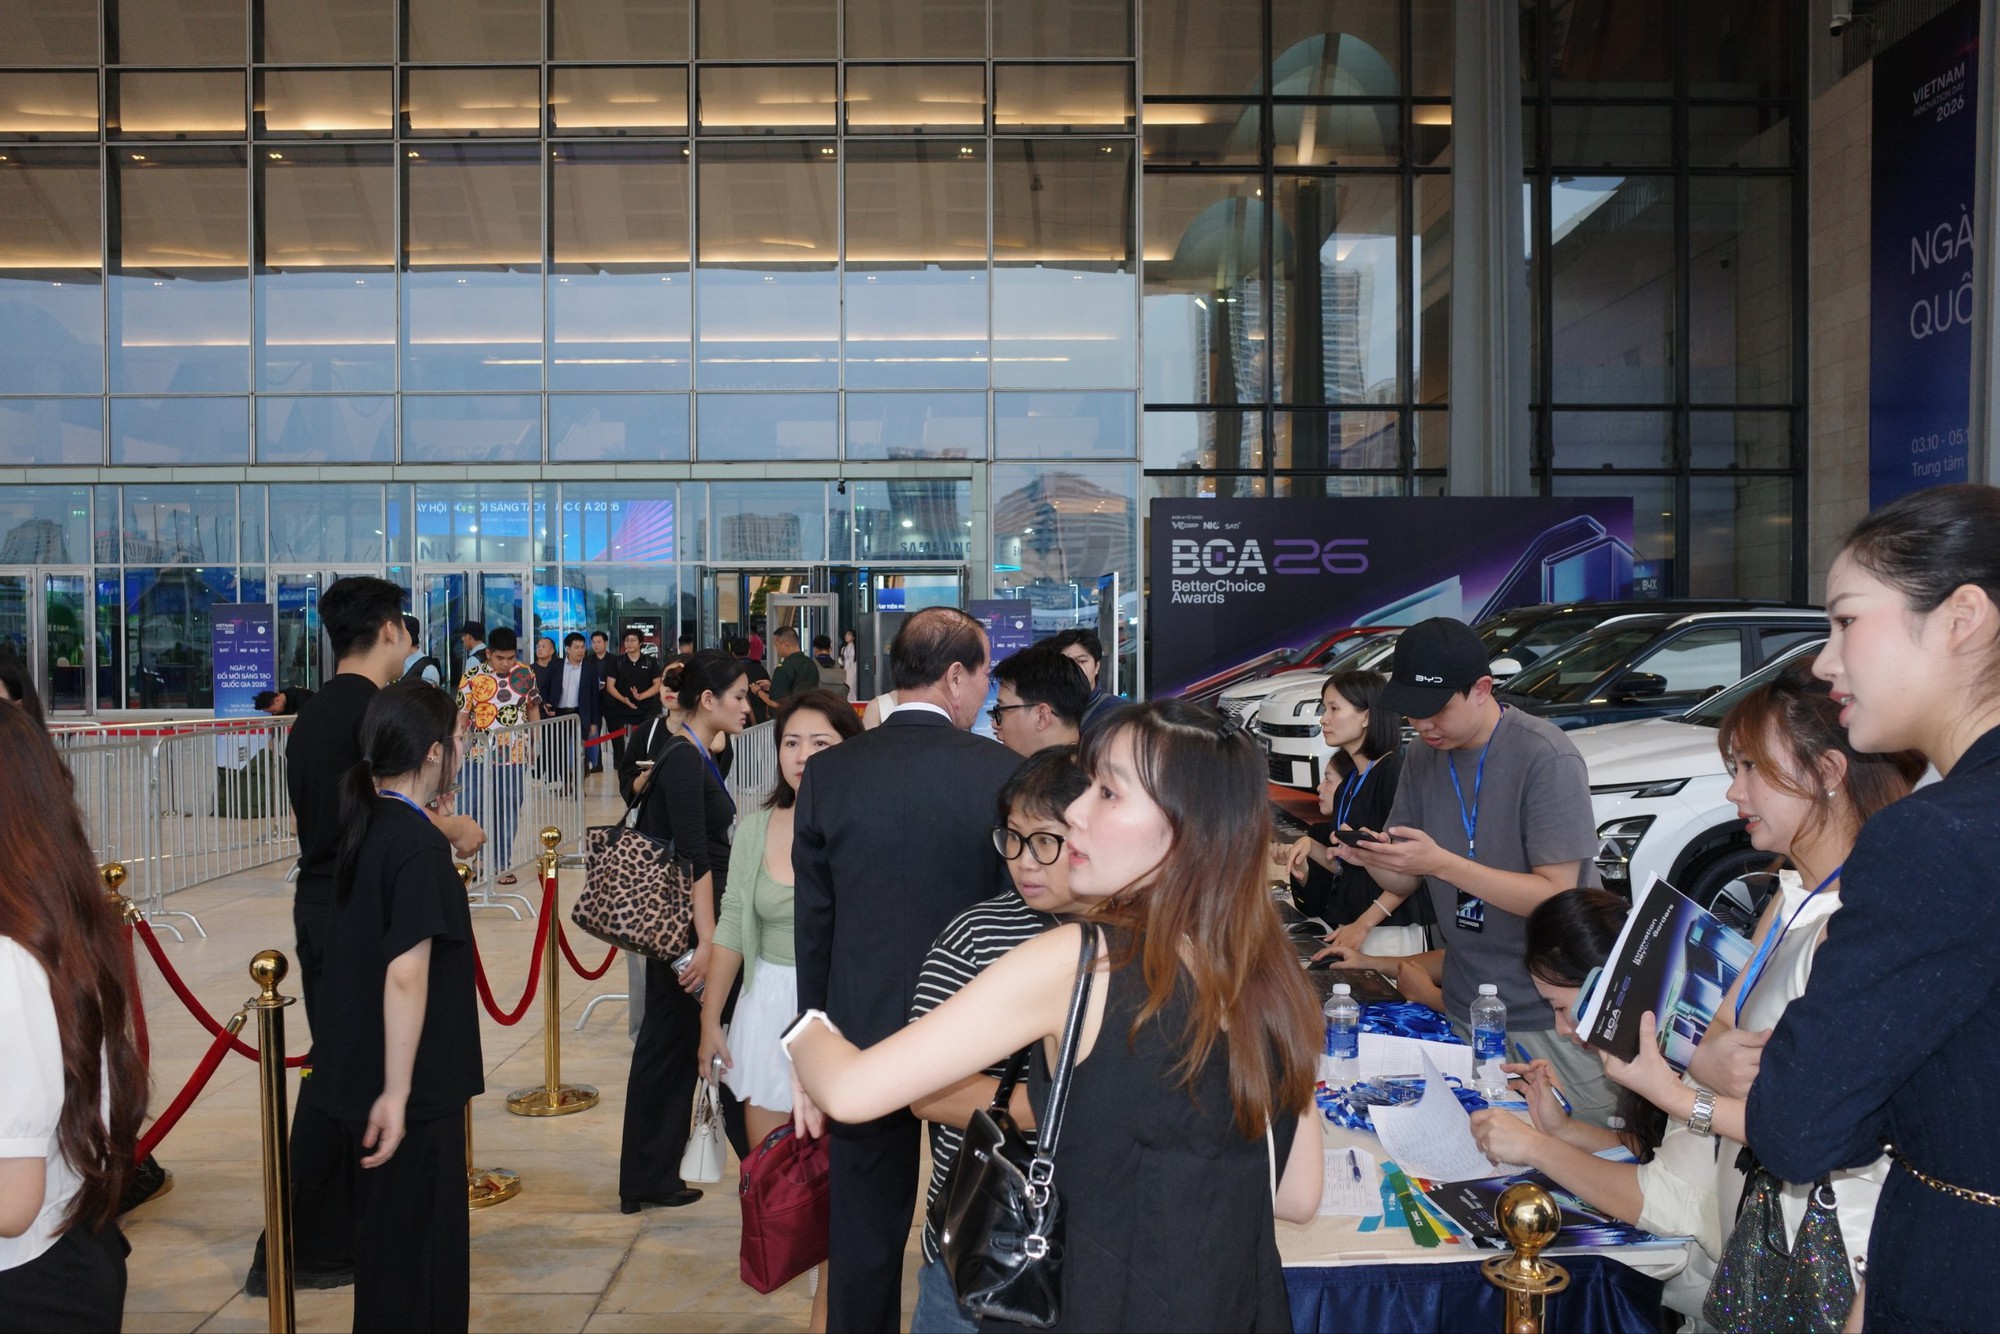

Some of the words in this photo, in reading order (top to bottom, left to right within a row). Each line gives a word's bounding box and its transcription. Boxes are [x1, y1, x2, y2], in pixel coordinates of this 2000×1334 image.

[1913, 62, 1965, 104] VIETNAM
[1913, 90, 1951, 118] INNOVATION
[1952, 81, 1965, 95] DAY
[1936, 94, 1965, 122] 2026
[1911, 203, 1974, 275] NGÀ
[1911, 434, 1939, 454] 03.10
[1948, 428, 1969, 446] 05.
[1912, 461, 1941, 477] Trung
[1943, 455, 1965, 472] tâm
[429, 501, 447, 514] HỘI
[490, 501, 519, 512] SÁNG
[574, 502, 592, 512] GA
[594, 502, 620, 512] 206
[900, 541, 971, 553] SAMSUNG
[1172, 538, 1268, 575] BCA
[1273, 538, 1369, 575] 26
[1171, 579, 1266, 592] BetterChoice
[1171, 591, 1225, 604] Awards
[229, 664, 246, 672] NGÀY
[247, 664, 258, 672] HỘI
[241, 672, 259, 680] SÁNG
[259, 673, 271, 681] TẠO
[1415, 674, 1443, 684] BYD
[221, 680, 240, 688] QUỐC
[1652, 903, 1675, 938] Borders
[1632, 917, 1658, 965] Innovation
[1603, 1008, 1620, 1039] BCA
